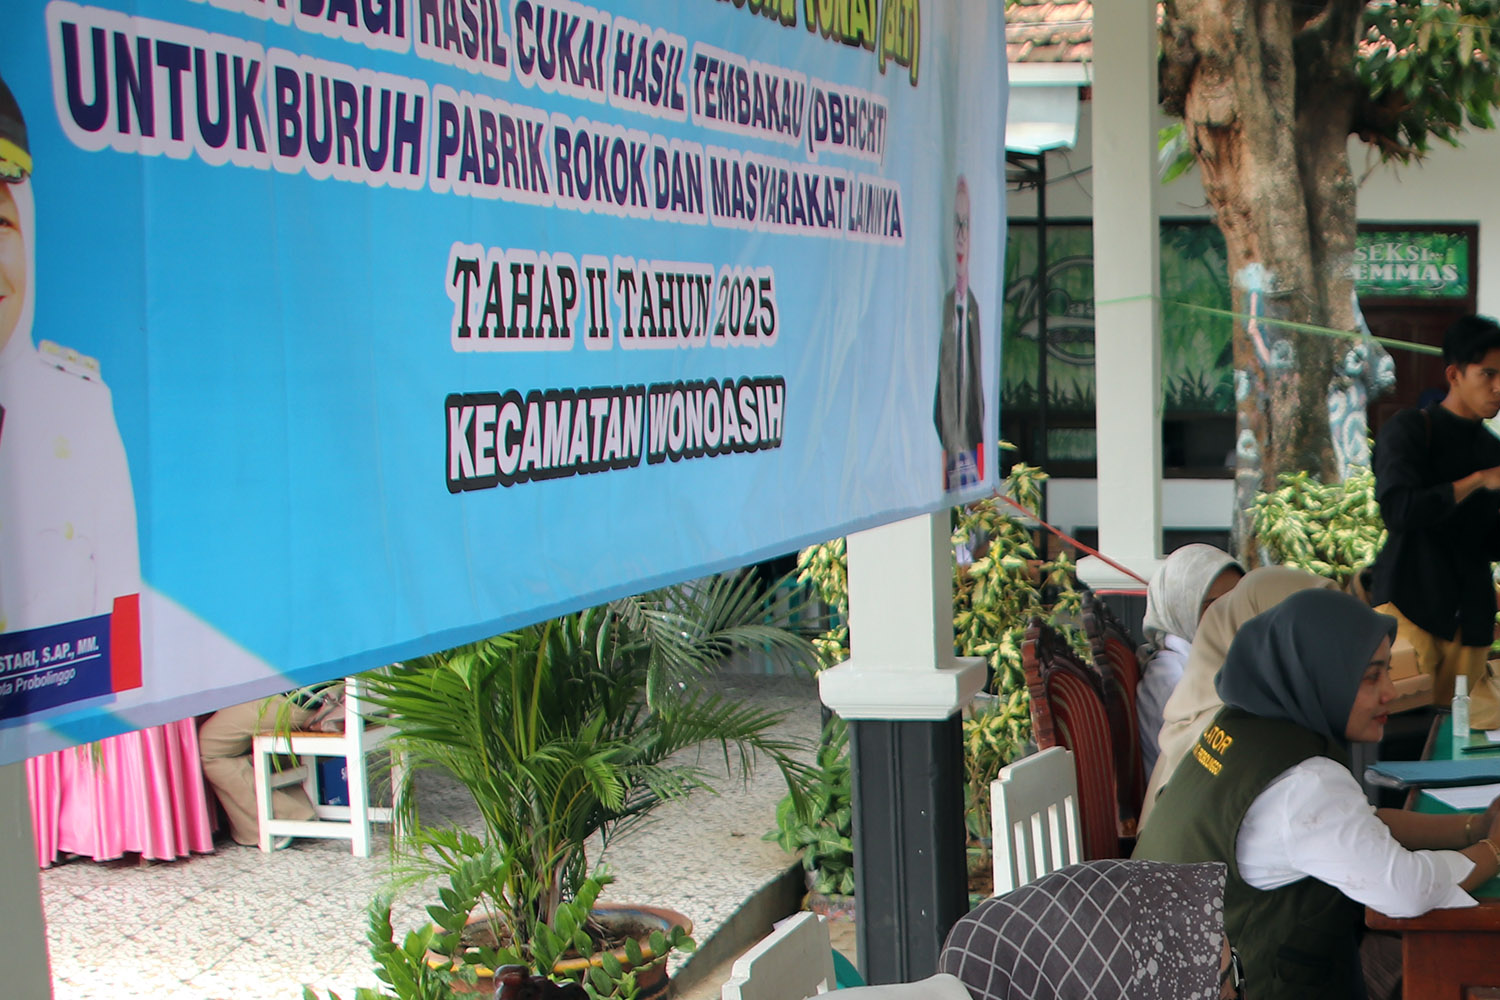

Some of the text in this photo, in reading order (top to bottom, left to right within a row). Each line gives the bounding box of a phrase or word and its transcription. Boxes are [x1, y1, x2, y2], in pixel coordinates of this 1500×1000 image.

[419, 0, 507, 67] HASIL
[515, 0, 607, 91] CUKAI
[613, 29, 684, 111] HASIL
[693, 53, 805, 139] TEMBAKAU
[61, 21, 903, 237] UNTUK BURUH PABRIK ROKOK DAN MASYARAKAT LAINNYA
[453, 256, 775, 338] TAHAP II TAHUN 2025
[449, 384, 784, 480] KECAMATAN WONOASIH
[15, 668, 76, 693] Probolinggo
